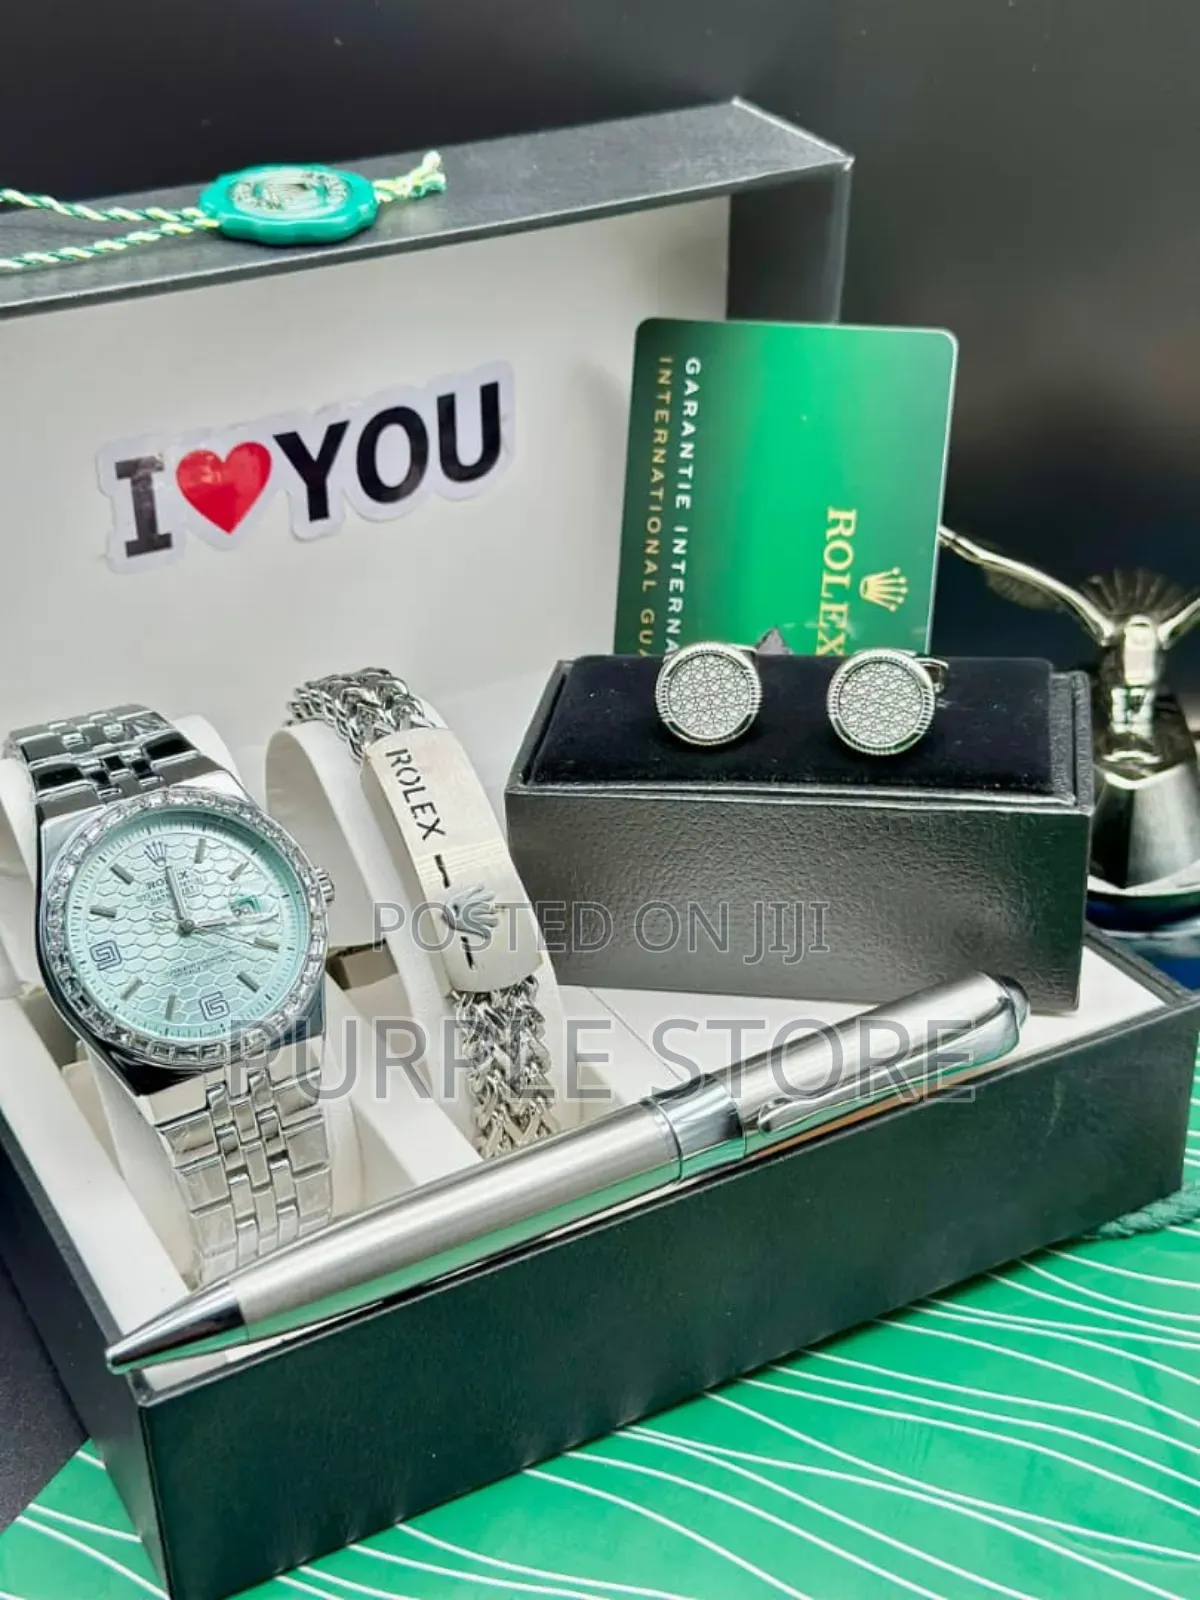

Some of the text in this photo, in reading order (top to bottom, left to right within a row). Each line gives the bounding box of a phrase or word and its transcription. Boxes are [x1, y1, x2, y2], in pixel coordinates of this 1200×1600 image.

[115, 381, 500, 558] I YOU
[641, 355, 674, 593] INTERNATIONAL
[675, 357, 702, 511] GARANTIE
[814, 505, 858, 656] ROLEX
[385, 748, 447, 842] ROLEX
